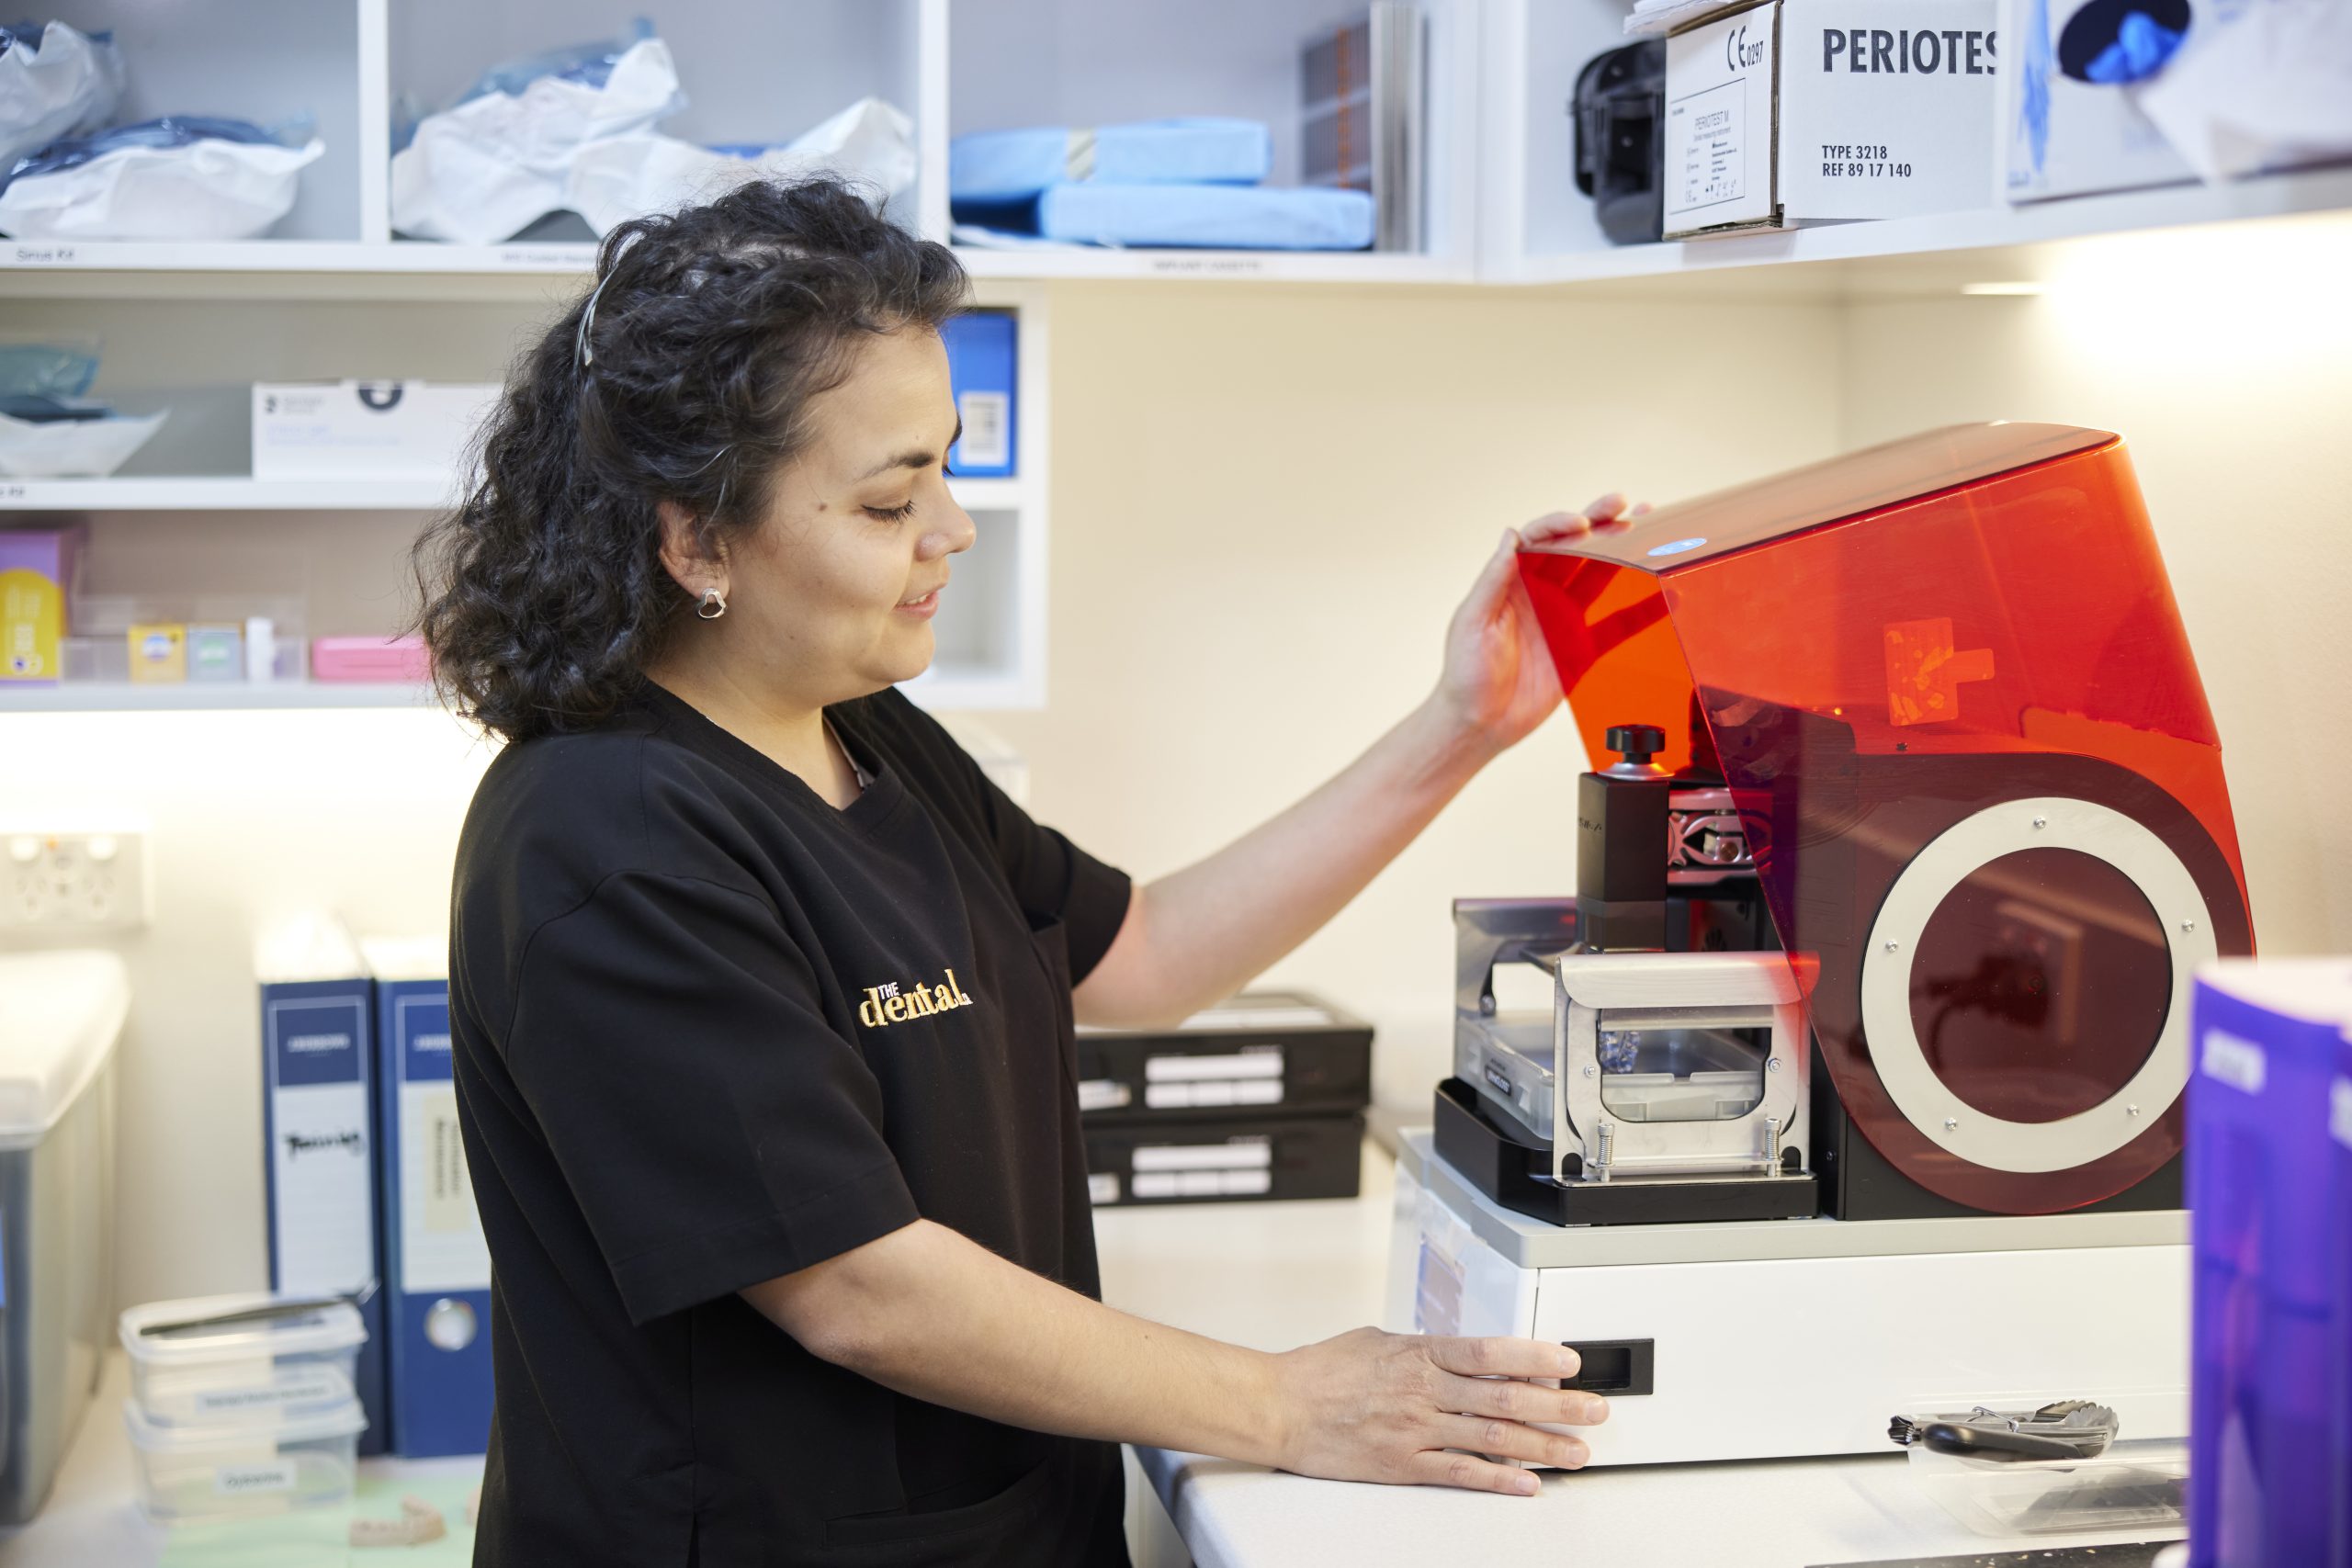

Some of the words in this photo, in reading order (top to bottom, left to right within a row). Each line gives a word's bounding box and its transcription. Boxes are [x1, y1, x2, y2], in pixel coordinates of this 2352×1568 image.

[1747, 39, 1764, 67] 0297
[1823, 28, 1997, 75] PERIOTES
[1822, 145, 1852, 159] TYPE
[1855, 145, 1887, 159] 3218
[1822, 163, 1844, 177] REF
[1848, 163, 1864, 177] 89
[1869, 163, 1884, 177] 17
[1889, 163, 1912, 177] 140
[877, 981, 900, 1000] THE
